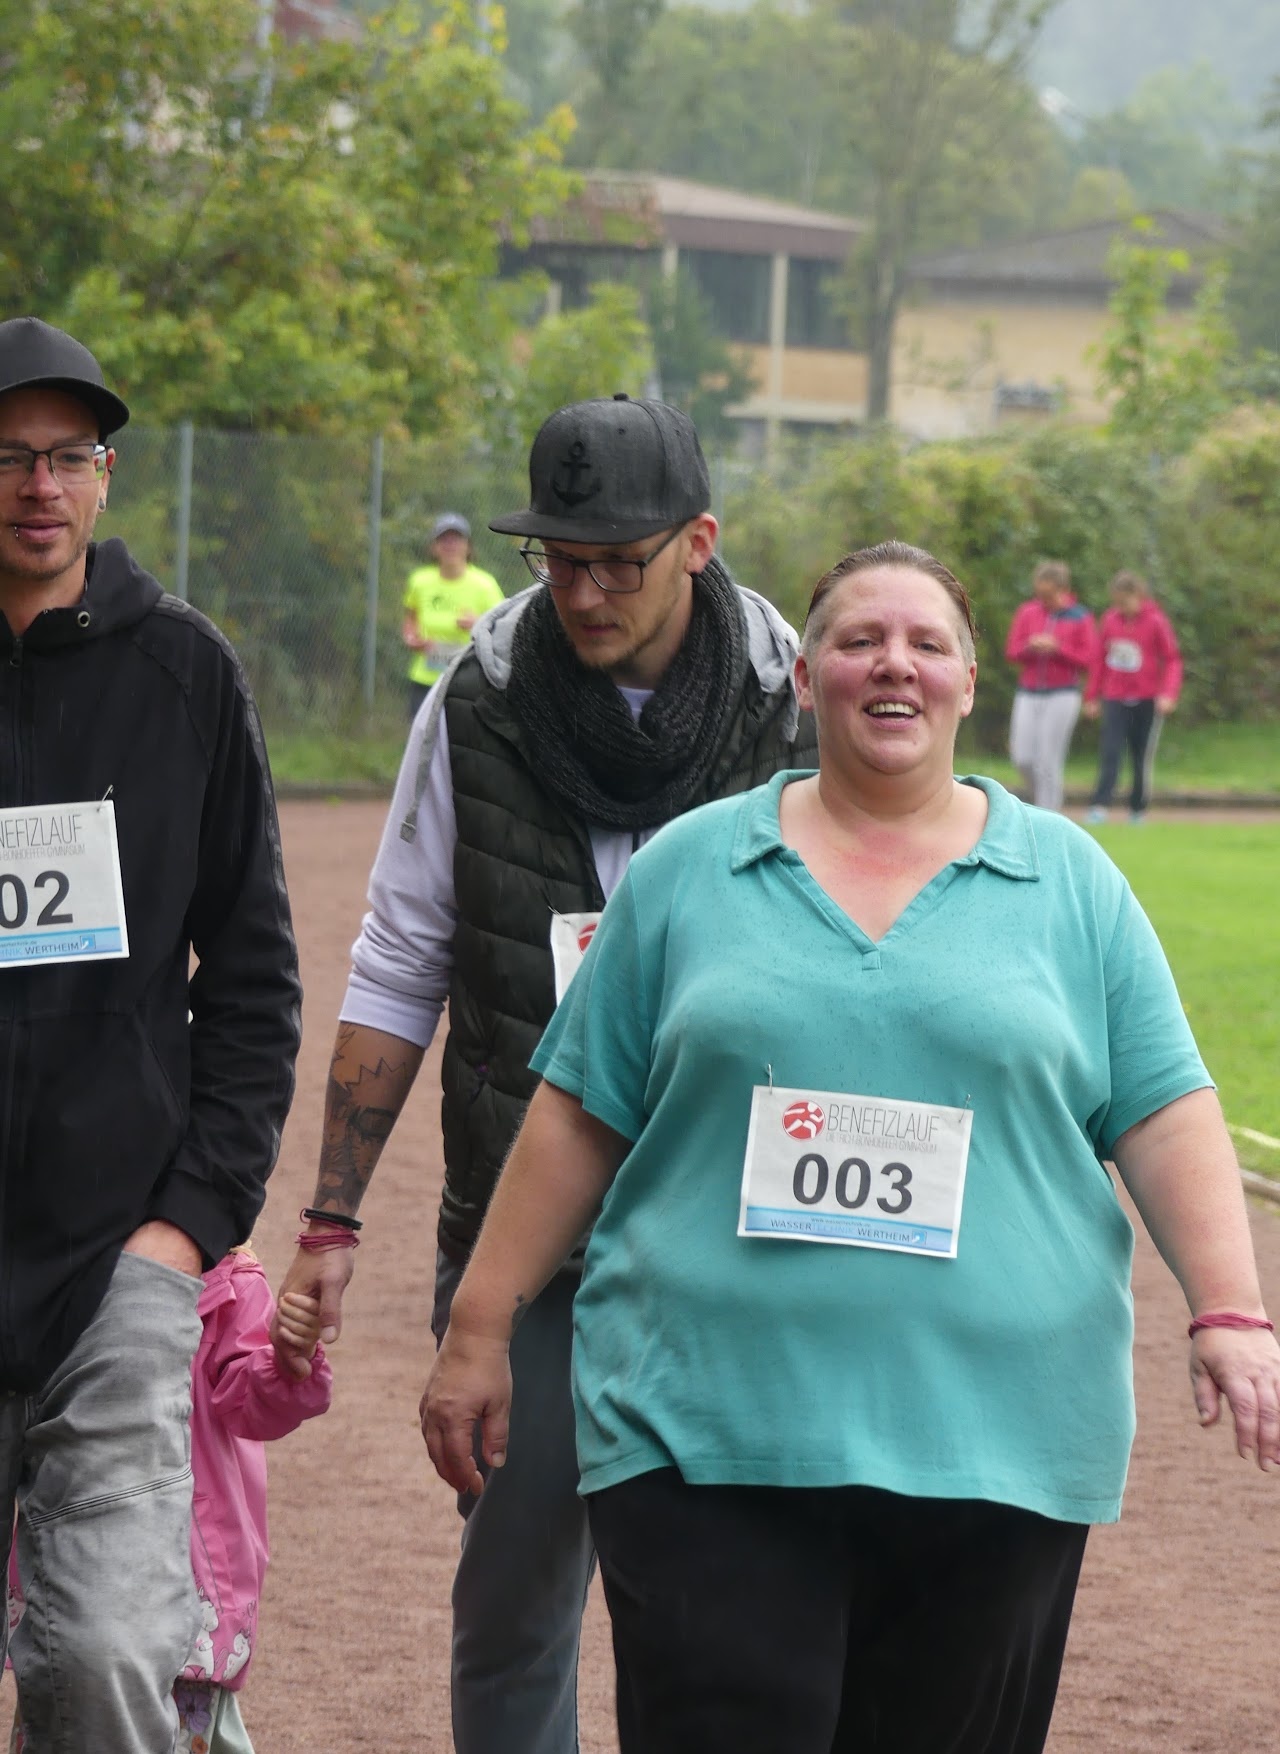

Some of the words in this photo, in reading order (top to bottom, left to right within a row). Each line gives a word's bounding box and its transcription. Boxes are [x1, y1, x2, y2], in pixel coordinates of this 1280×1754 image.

[25, 941, 79, 956] WERTHEIM
[827, 1103, 941, 1142] BENEFIZLAUF
[792, 1153, 913, 1214] 003
[857, 1227, 911, 1243] WERTHEIM
